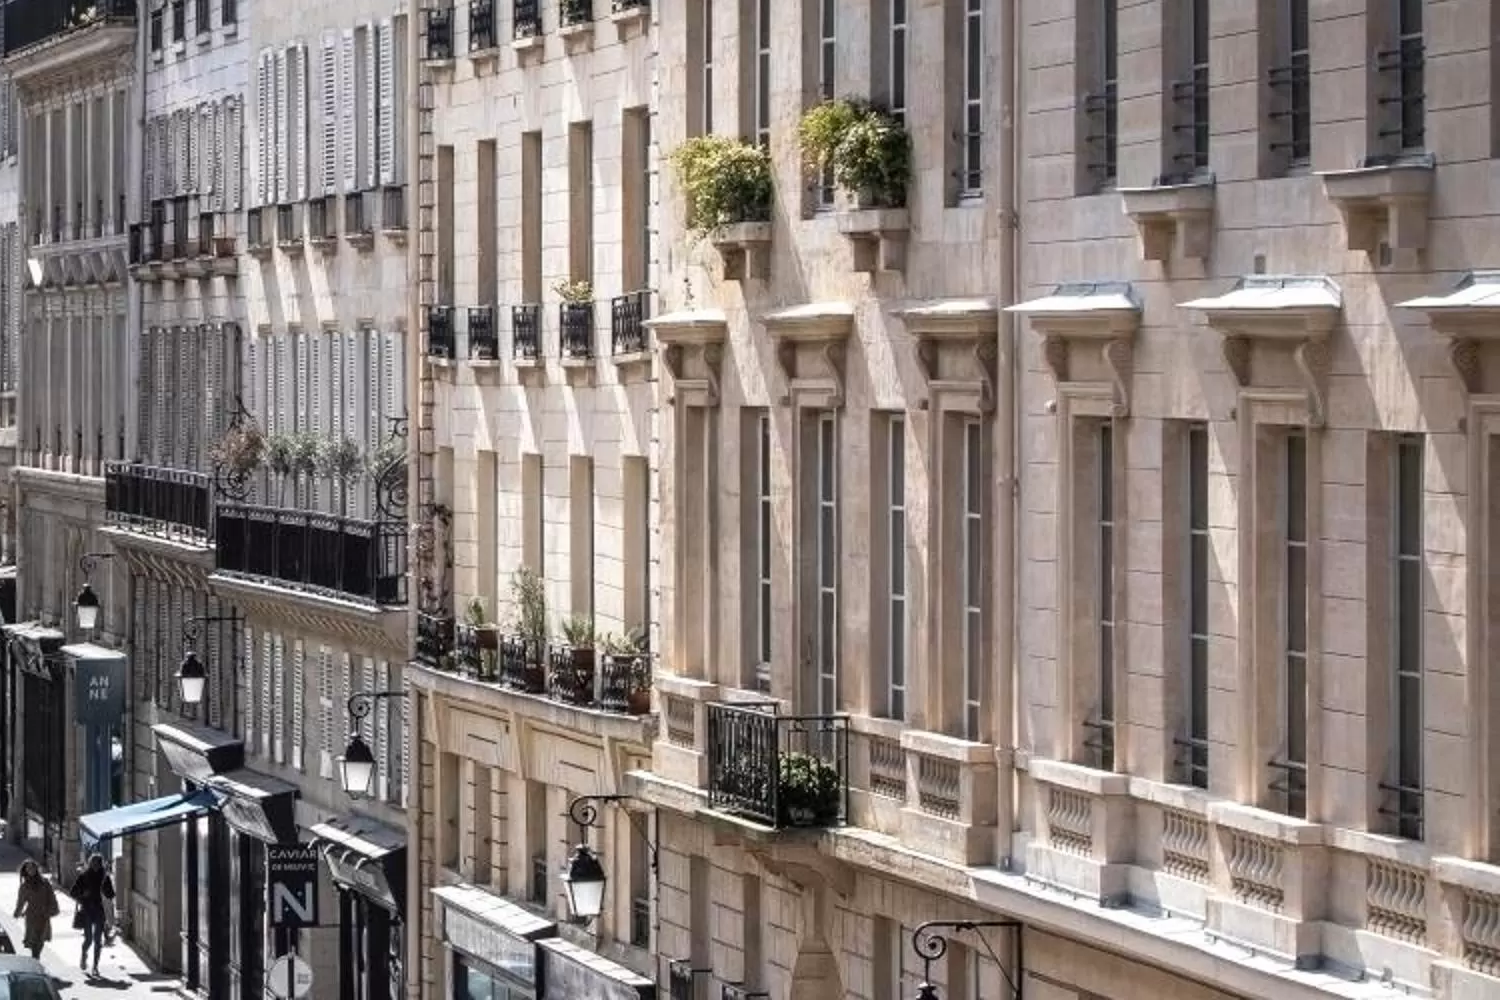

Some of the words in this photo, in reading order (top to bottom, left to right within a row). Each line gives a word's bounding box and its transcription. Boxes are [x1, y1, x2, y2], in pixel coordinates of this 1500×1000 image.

[90, 676, 109, 687] AN
[269, 849, 317, 860] CAVIAR
[273, 881, 314, 923] N
